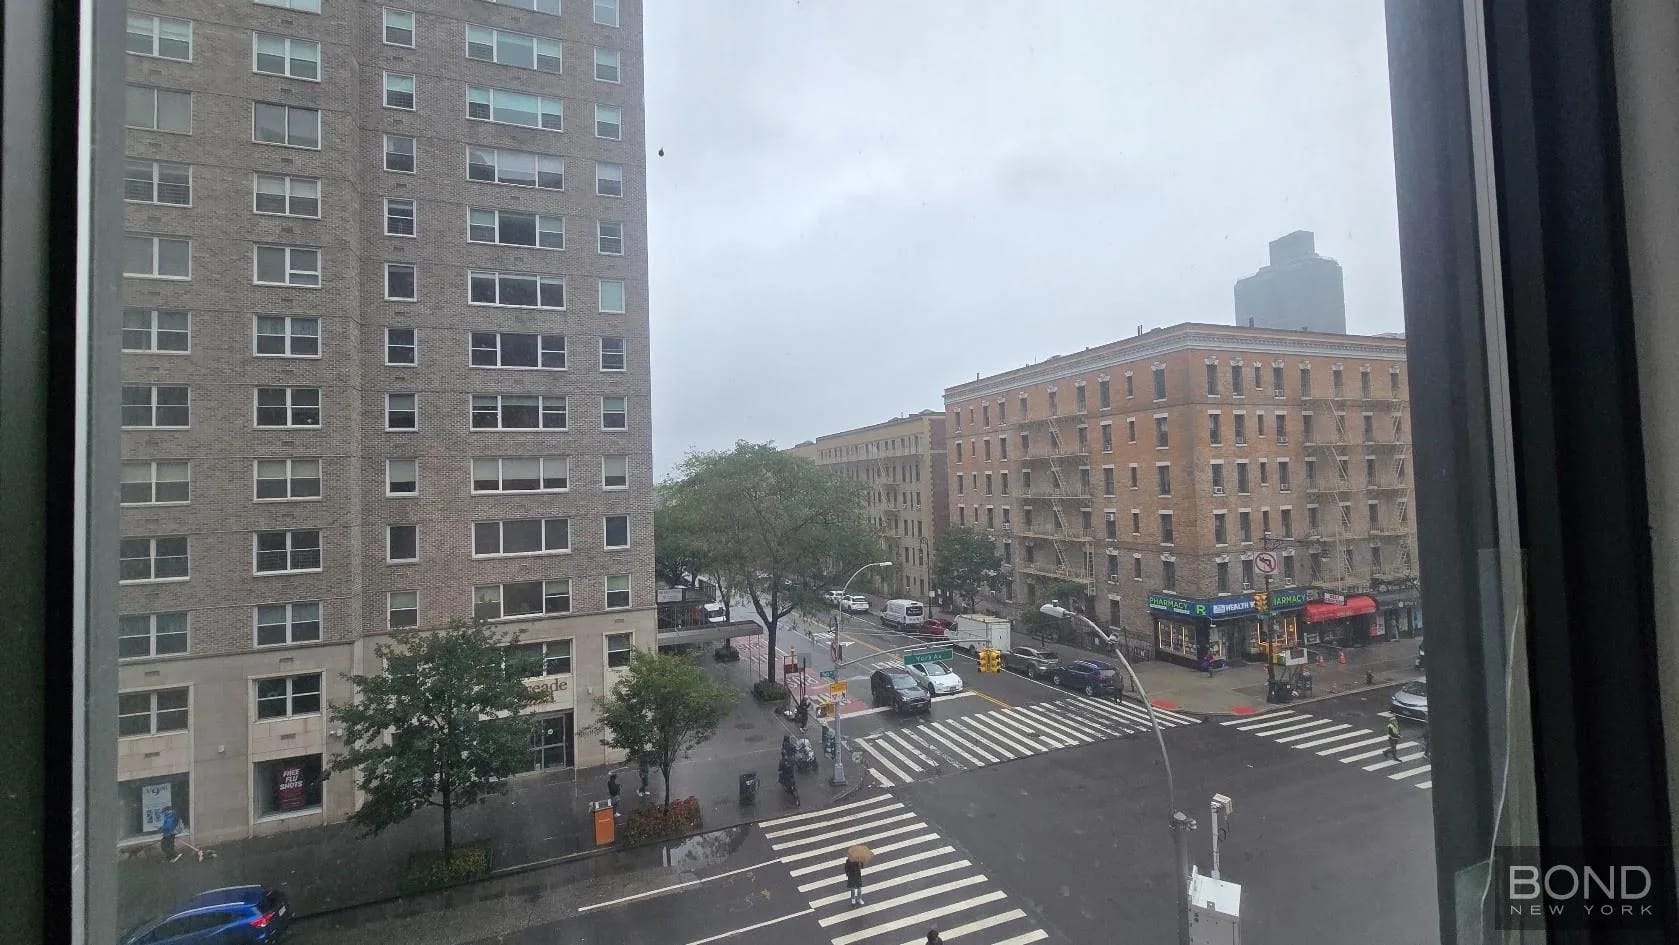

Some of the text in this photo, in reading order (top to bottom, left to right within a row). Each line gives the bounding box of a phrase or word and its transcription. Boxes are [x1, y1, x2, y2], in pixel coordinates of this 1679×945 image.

[1149, 597, 1188, 610] PHARMACY
[282, 768, 301, 777] FREE
[279, 781, 303, 790] SHOTS
